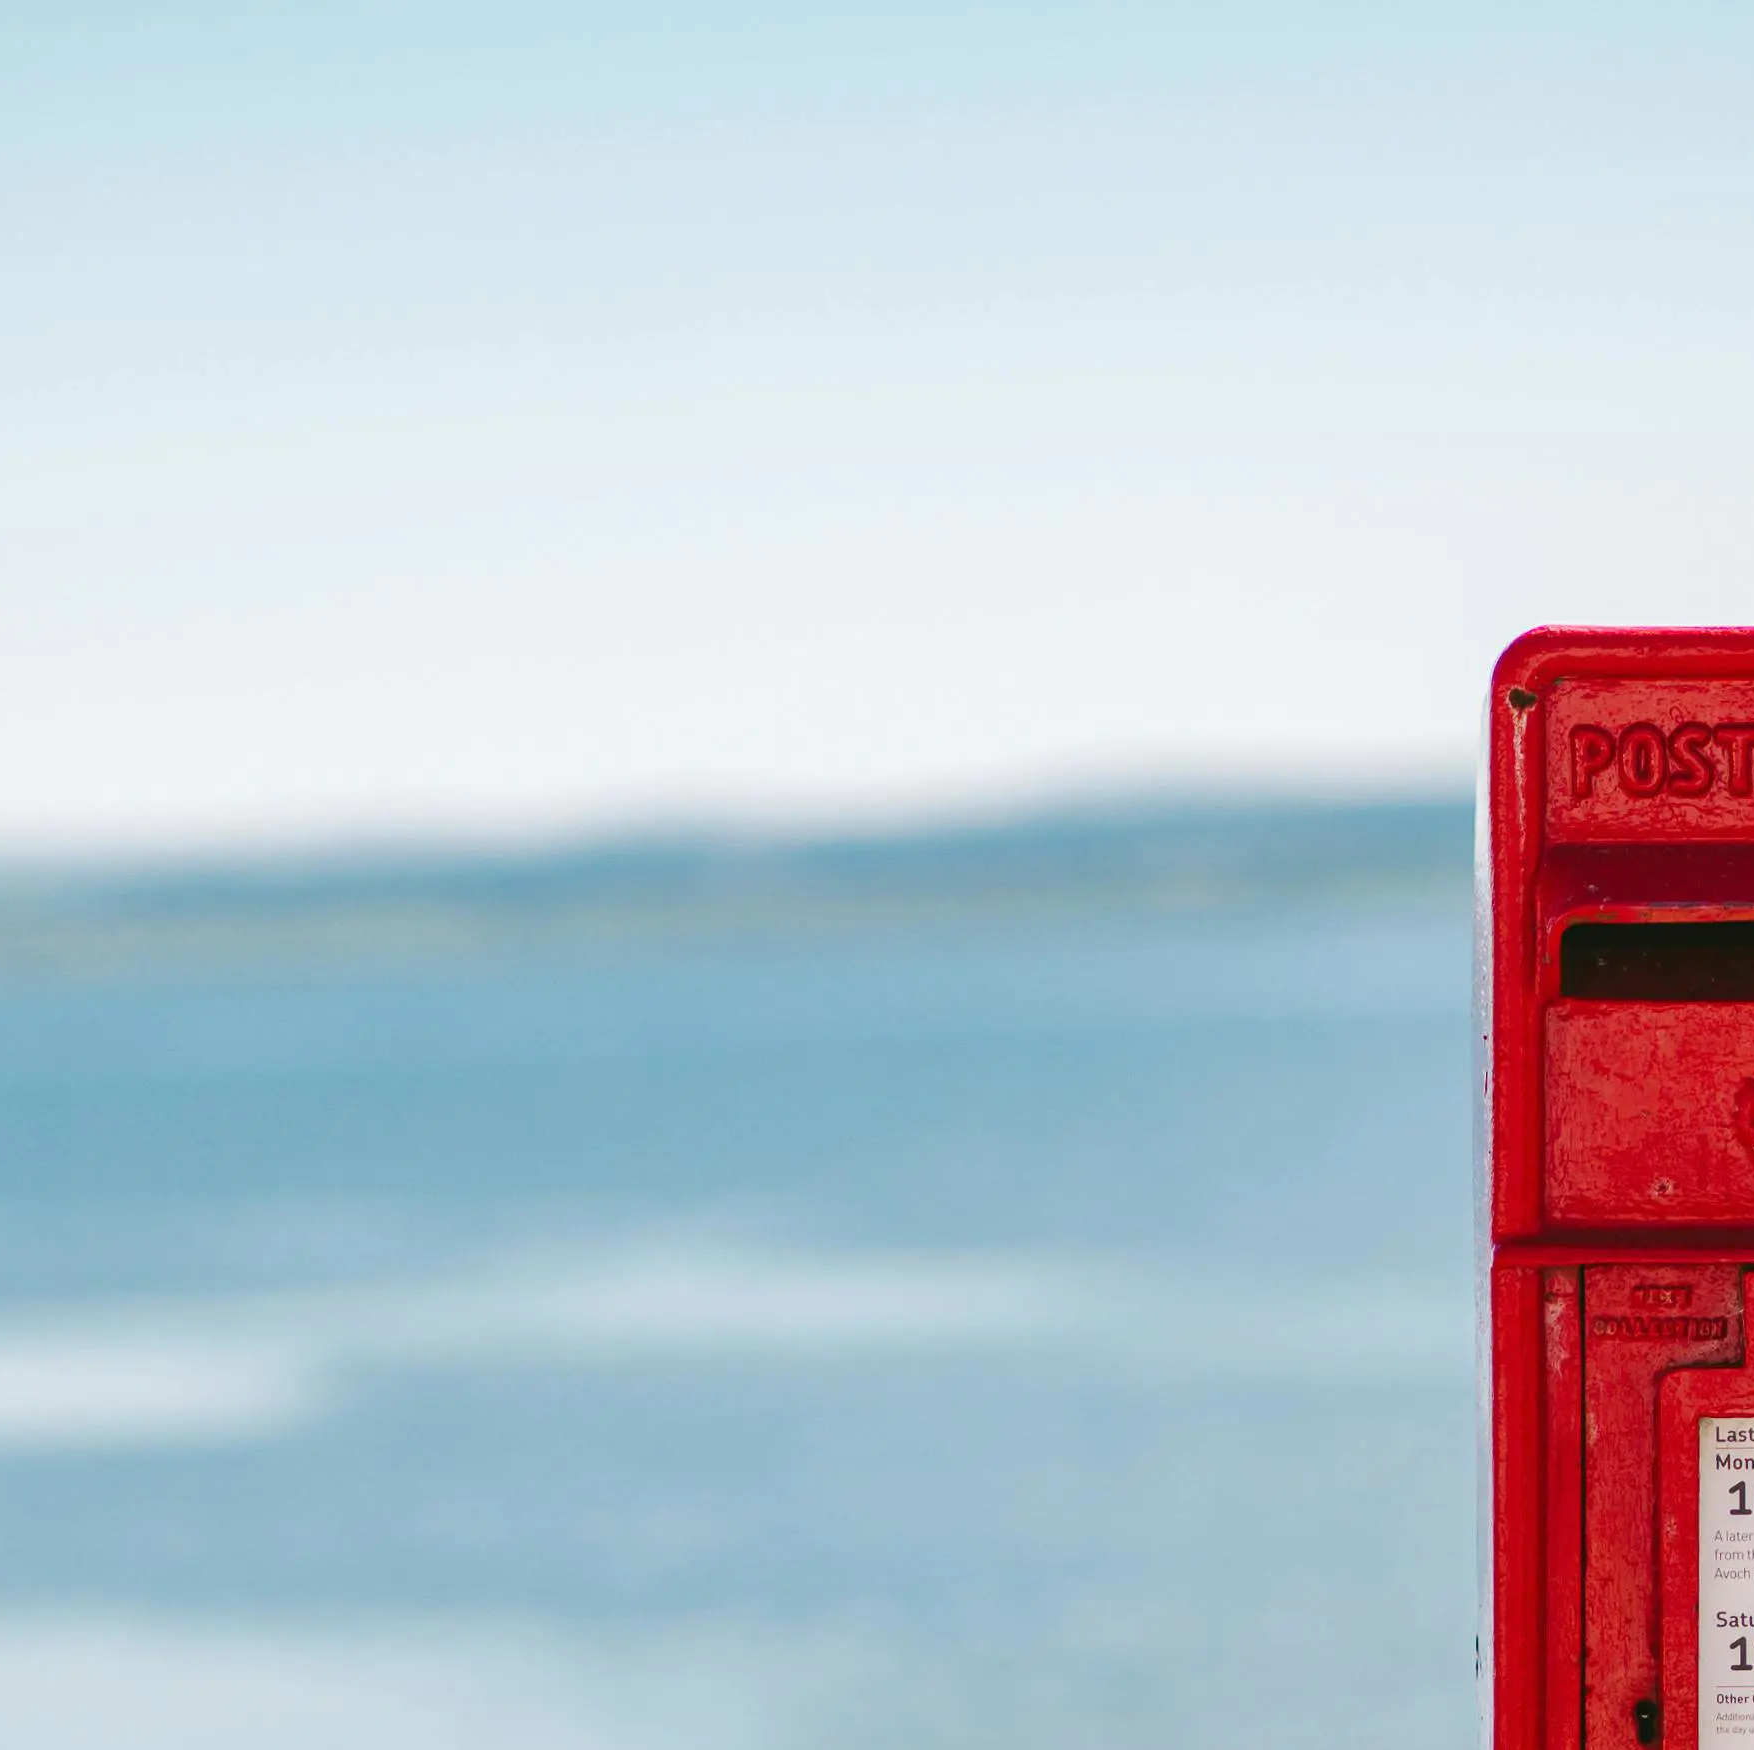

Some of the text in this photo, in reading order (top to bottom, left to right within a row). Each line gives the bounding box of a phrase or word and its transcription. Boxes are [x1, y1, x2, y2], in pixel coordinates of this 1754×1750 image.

[1715, 1530, 1722, 1541] A
[1726, 1531, 1753, 1541] later
[1715, 1549, 1744, 1561] from
[1714, 1568, 1750, 1579] Avoch
[1717, 1694, 1749, 1704] Other
